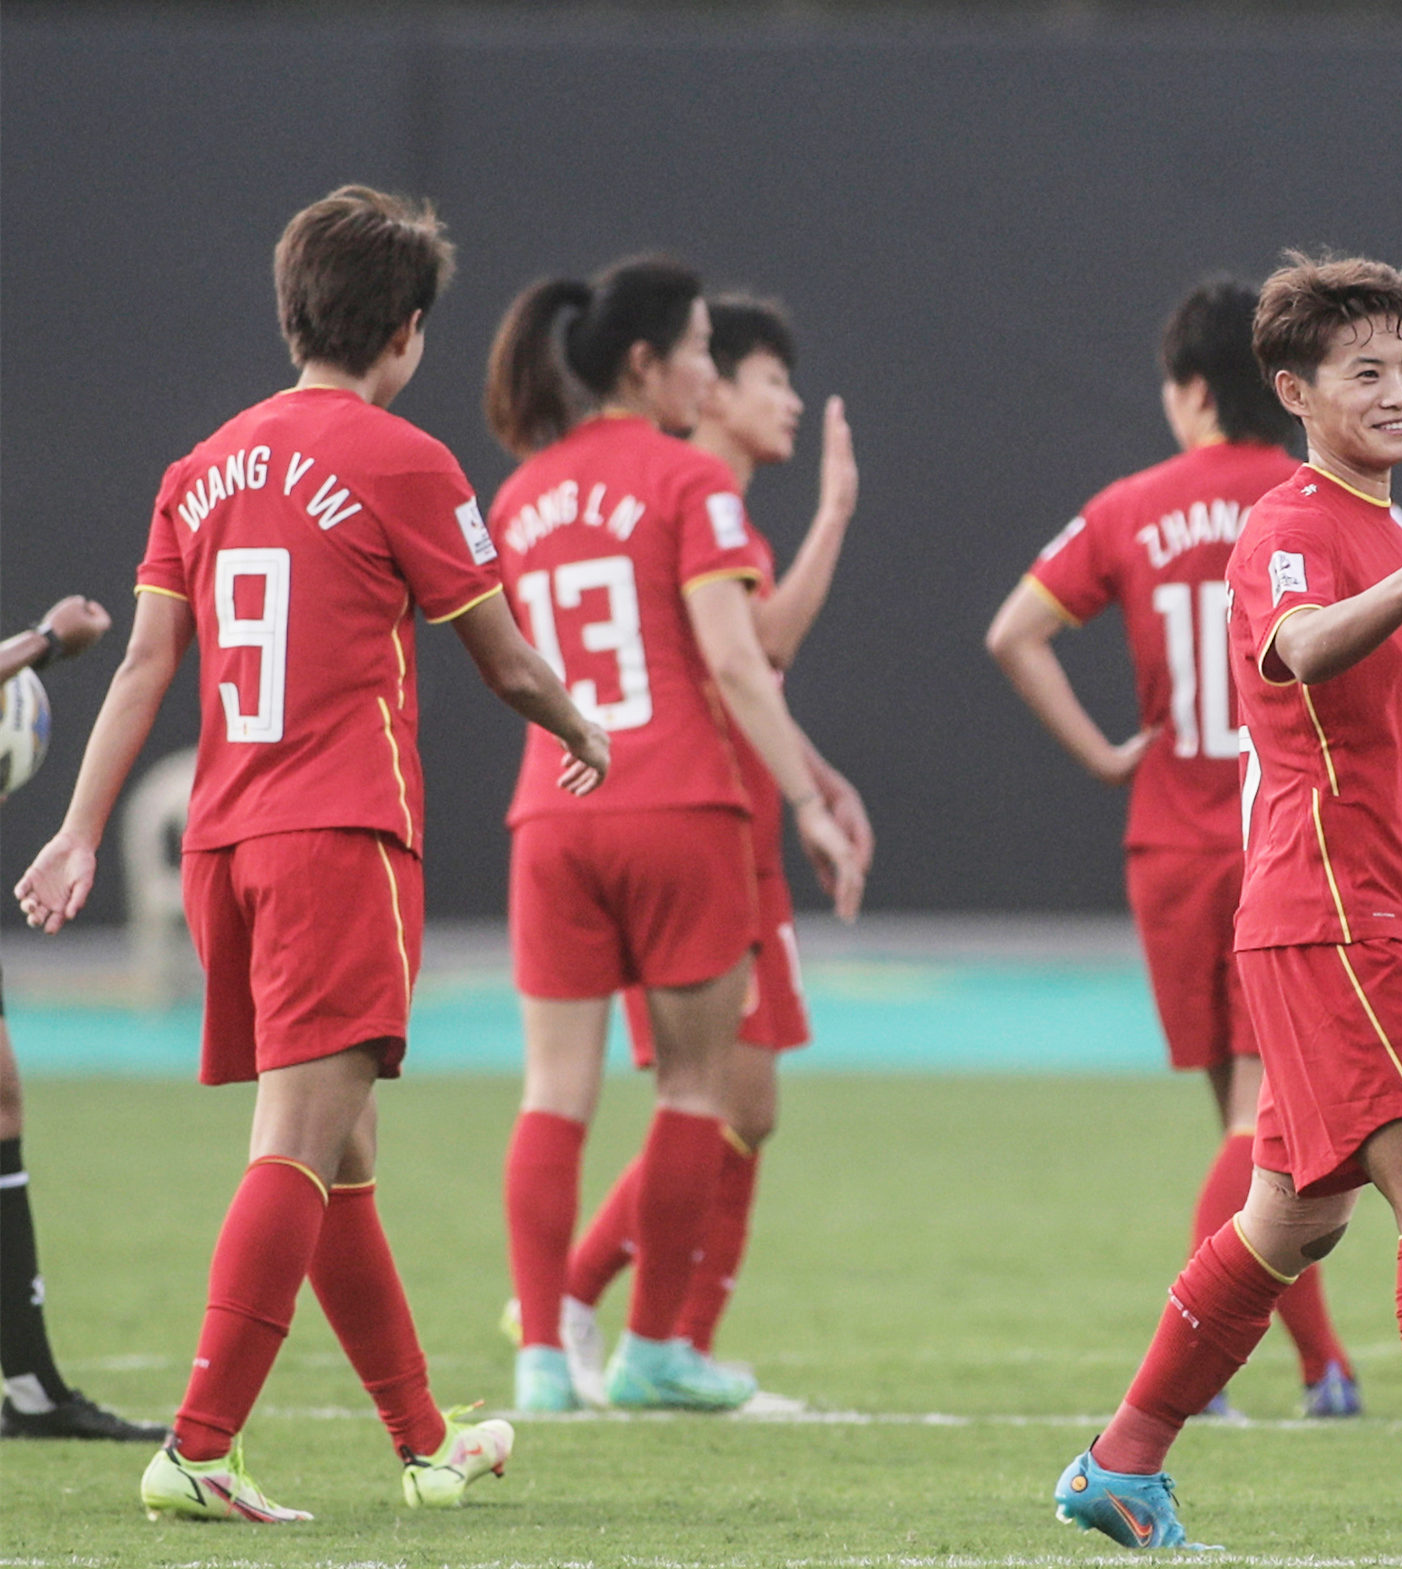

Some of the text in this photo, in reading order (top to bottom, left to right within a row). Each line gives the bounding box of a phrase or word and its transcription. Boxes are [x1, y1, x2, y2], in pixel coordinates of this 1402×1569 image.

[178, 445, 363, 533] WANG Y W
[583, 482, 606, 526] L
[607, 495, 646, 541] N
[1136, 498, 1251, 569] ZHAN
[215, 548, 290, 743] 9
[518, 555, 653, 732] 13
